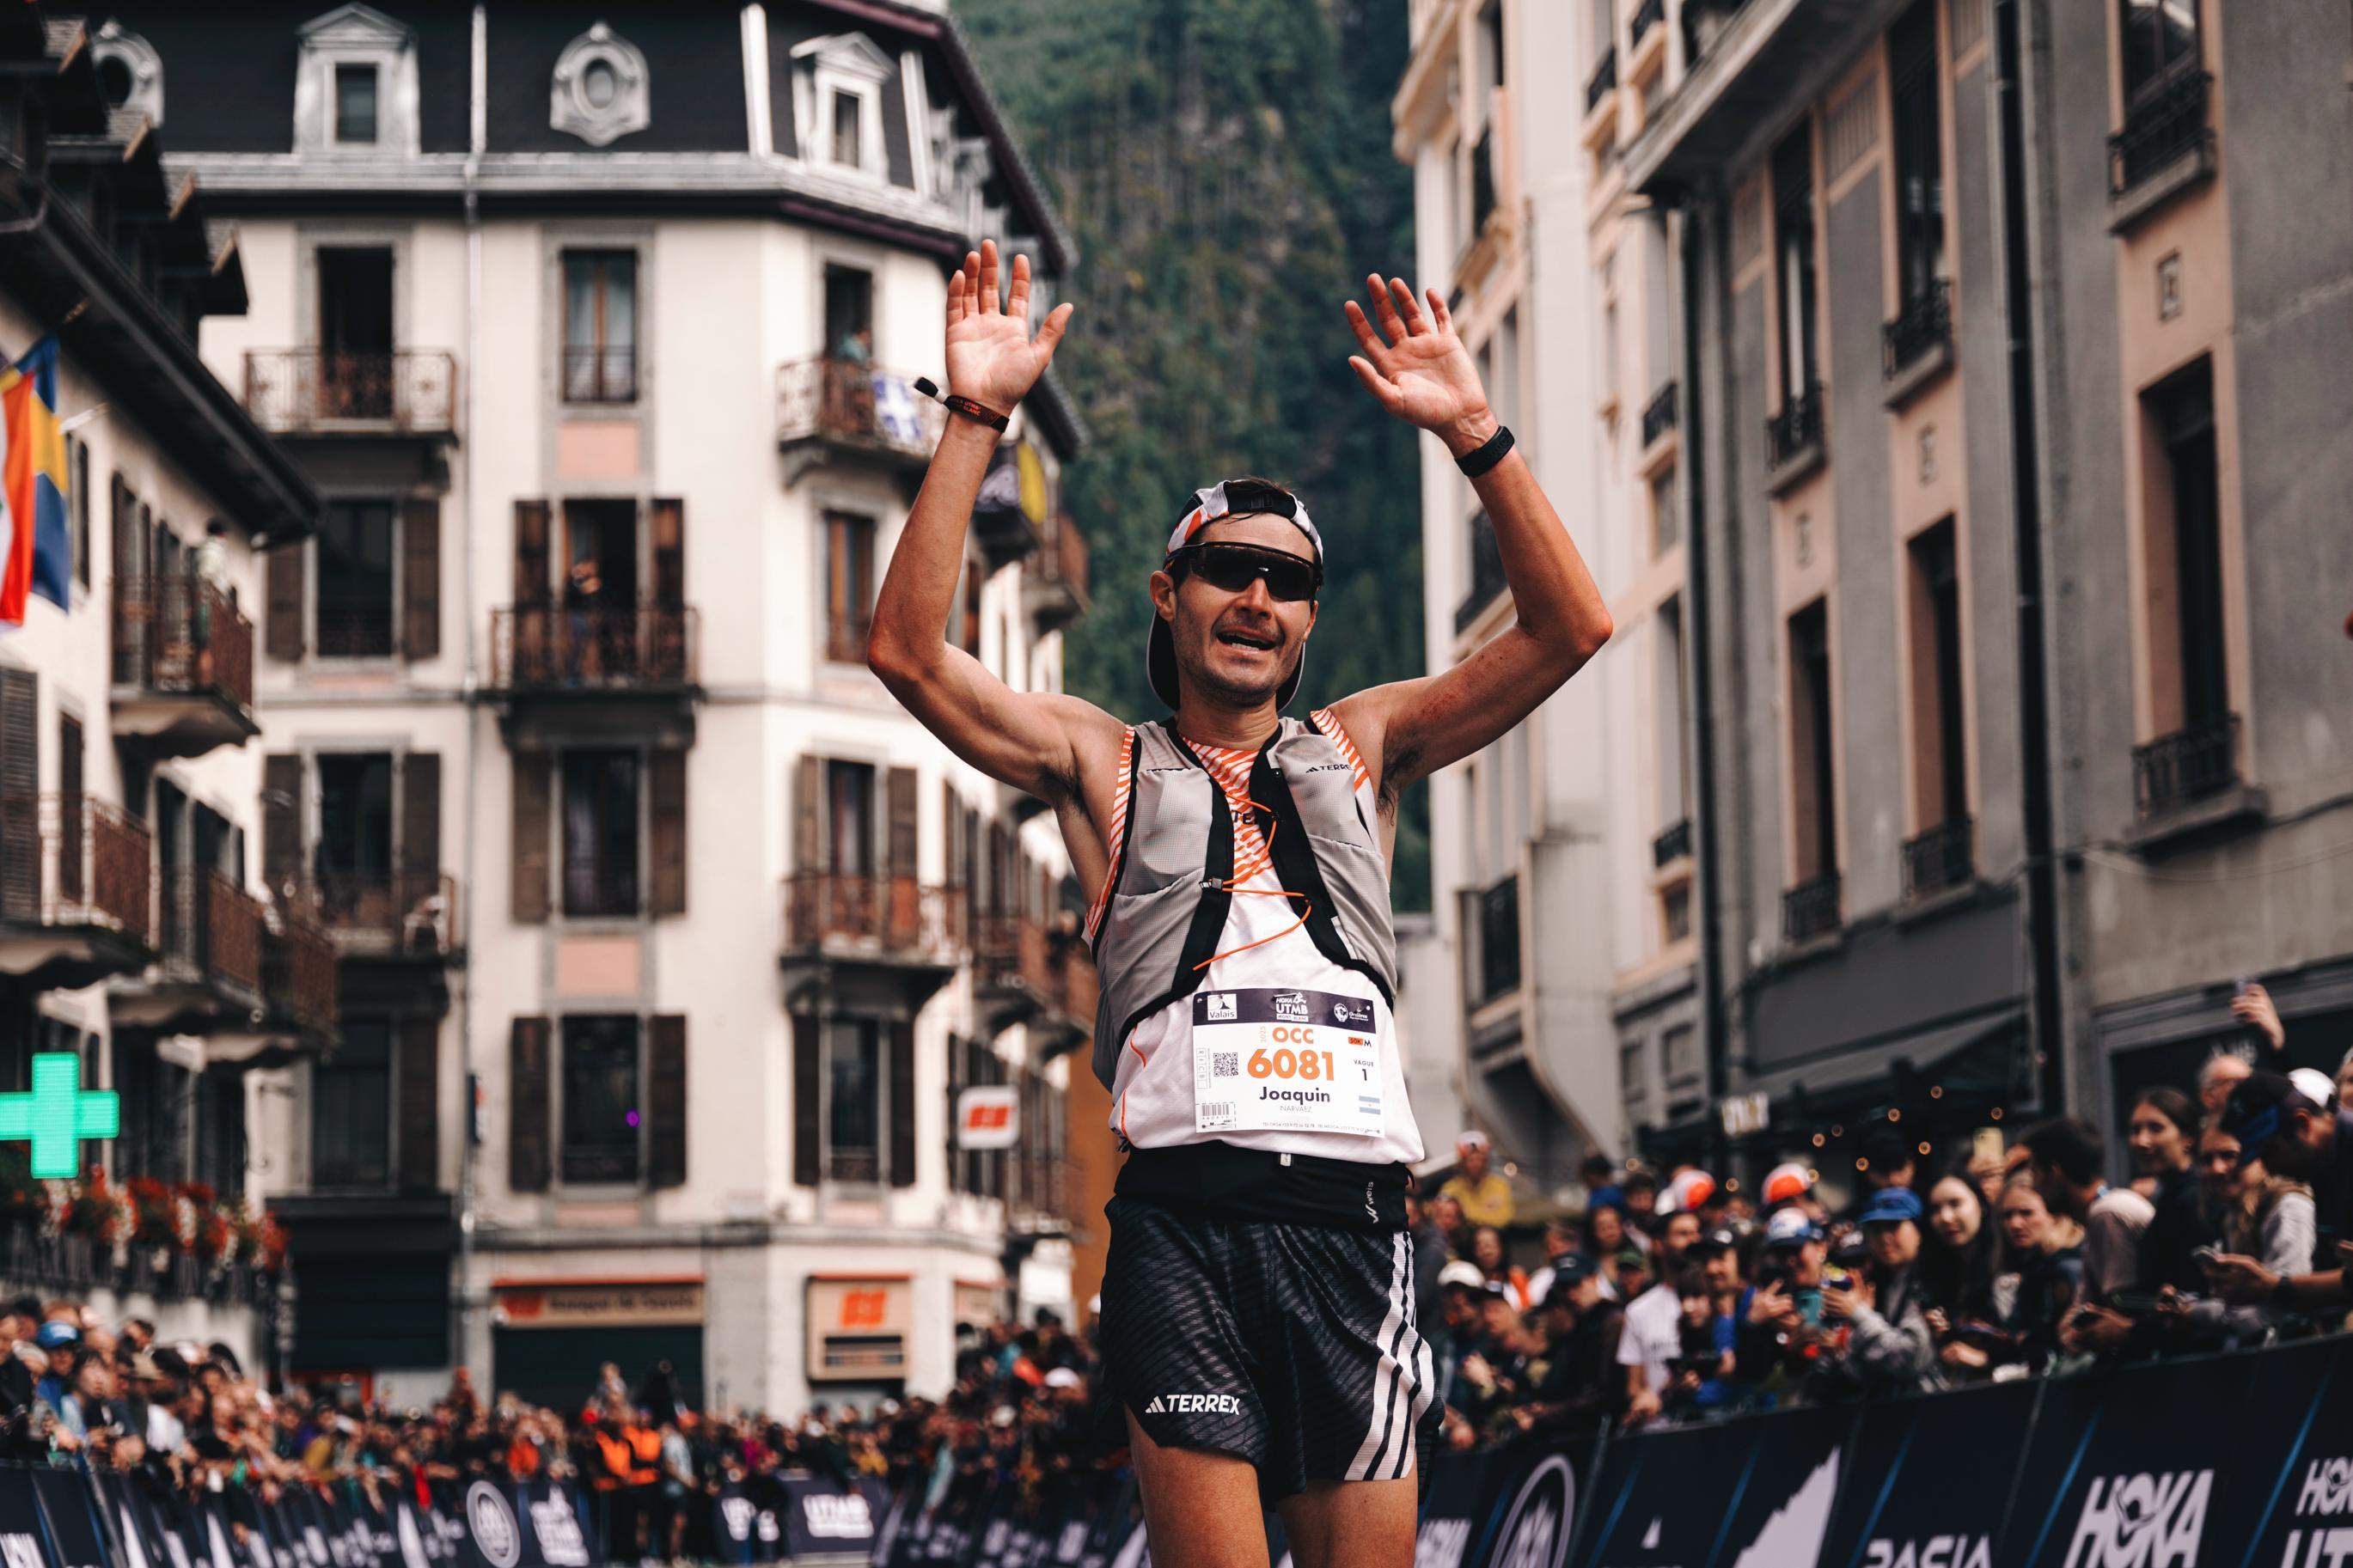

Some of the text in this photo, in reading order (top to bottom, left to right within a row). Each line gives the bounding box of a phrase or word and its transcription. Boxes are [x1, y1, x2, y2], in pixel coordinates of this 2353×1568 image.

[1209, 1010, 1235, 1019] Valais
[1275, 1003, 1308, 1015] UTMB
[1272, 1027, 1314, 1044] OCC
[1247, 1048, 1335, 1082] 6081
[1354, 1059, 1374, 1067] VAGUE
[1361, 1068, 1367, 1082] 1
[1259, 1086, 1331, 1106] Joaquin
[1166, 1394, 1241, 1416] TERREX
[2063, 1469, 2215, 1568] HOKA
